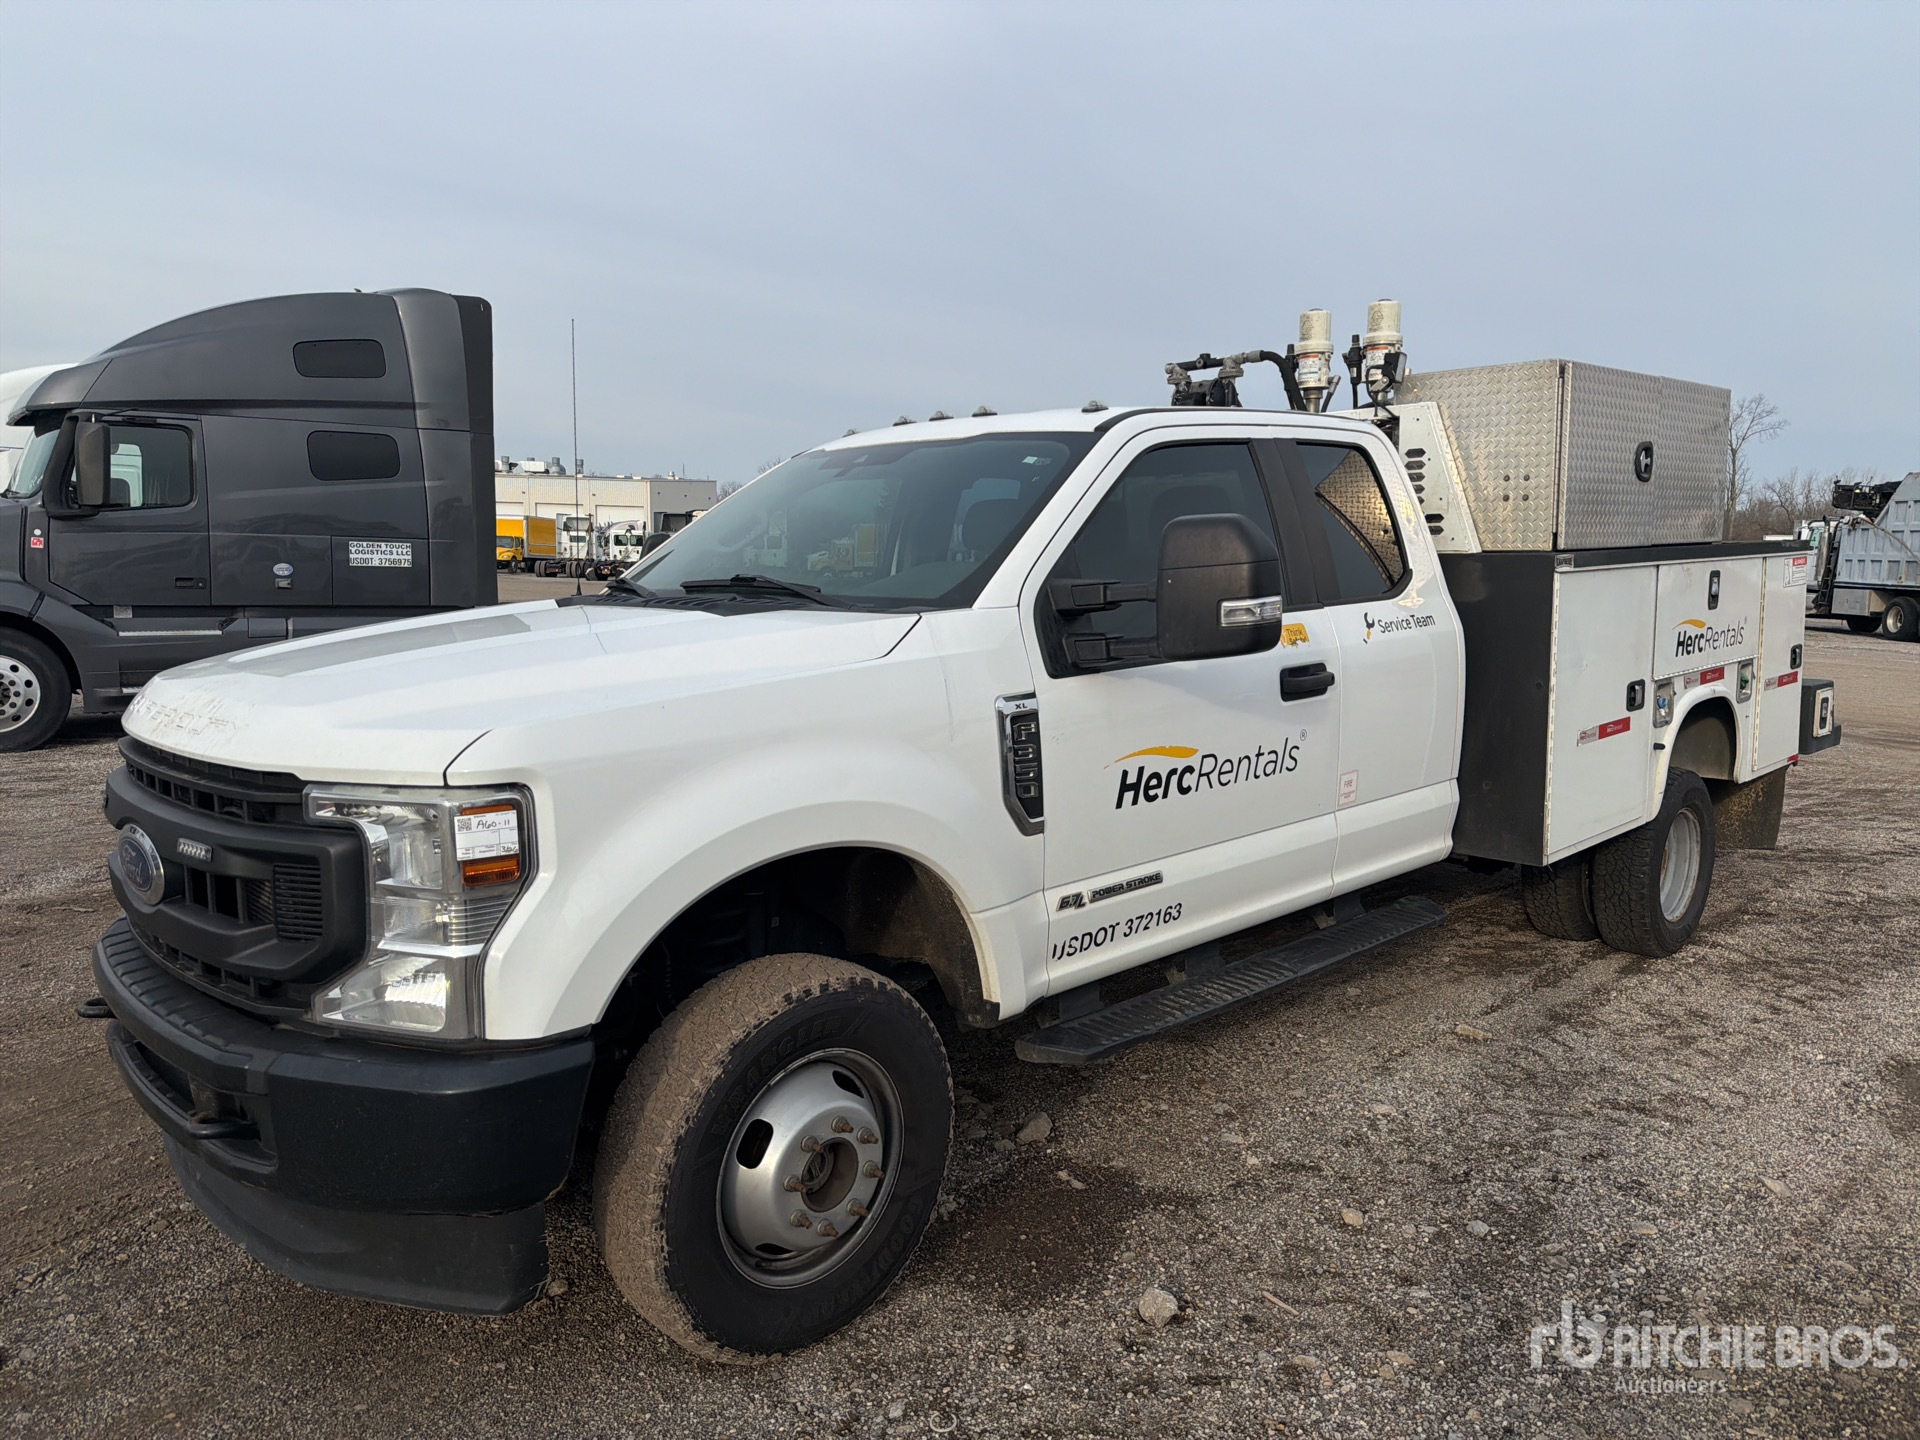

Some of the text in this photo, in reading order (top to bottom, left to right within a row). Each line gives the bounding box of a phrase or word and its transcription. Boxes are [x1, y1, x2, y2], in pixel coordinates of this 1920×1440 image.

[350, 557, 412, 566] USDOT: 3756975
[1377, 613, 1436, 634] Service Team
[1675, 620, 1745, 658] HercRentals
[1114, 737, 1300, 810] HercRentals
[1091, 883, 1125, 900] POWER
[1126, 872, 1162, 889] STROKE
[1052, 902, 1183, 961] USDOT 372163
